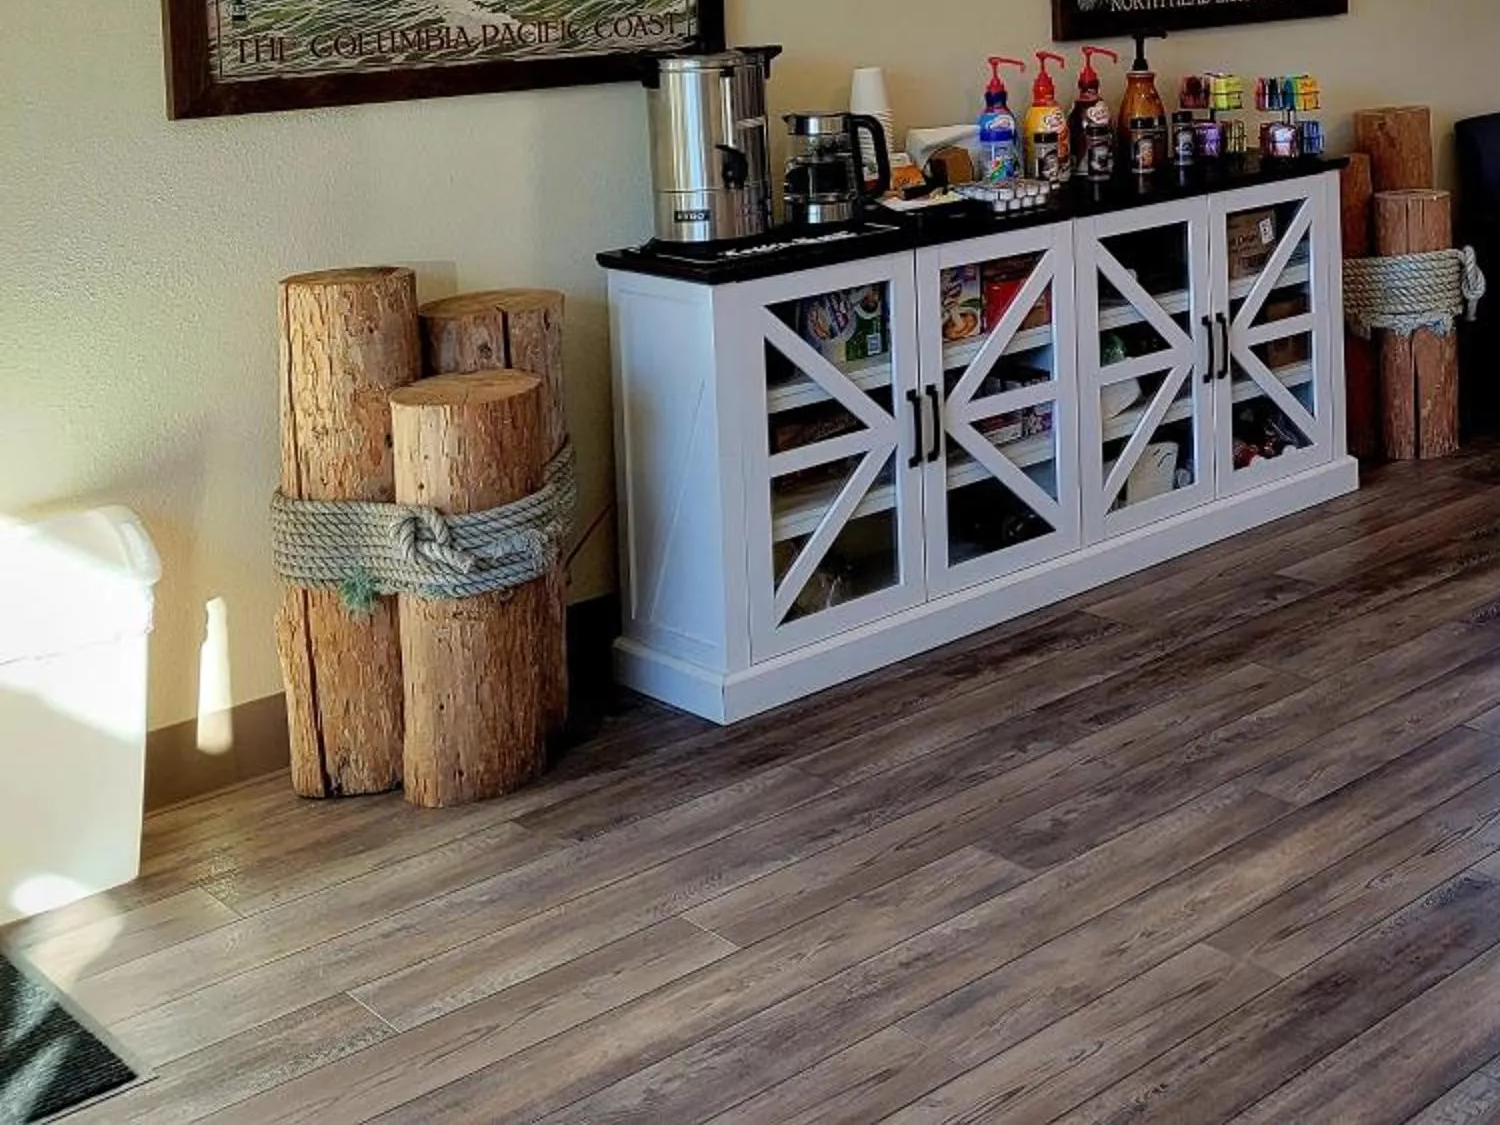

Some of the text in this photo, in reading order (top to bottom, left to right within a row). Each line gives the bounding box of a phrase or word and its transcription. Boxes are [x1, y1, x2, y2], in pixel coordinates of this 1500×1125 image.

[237, 11, 680, 64] THE COLUMBIA PACIFIC COAST
